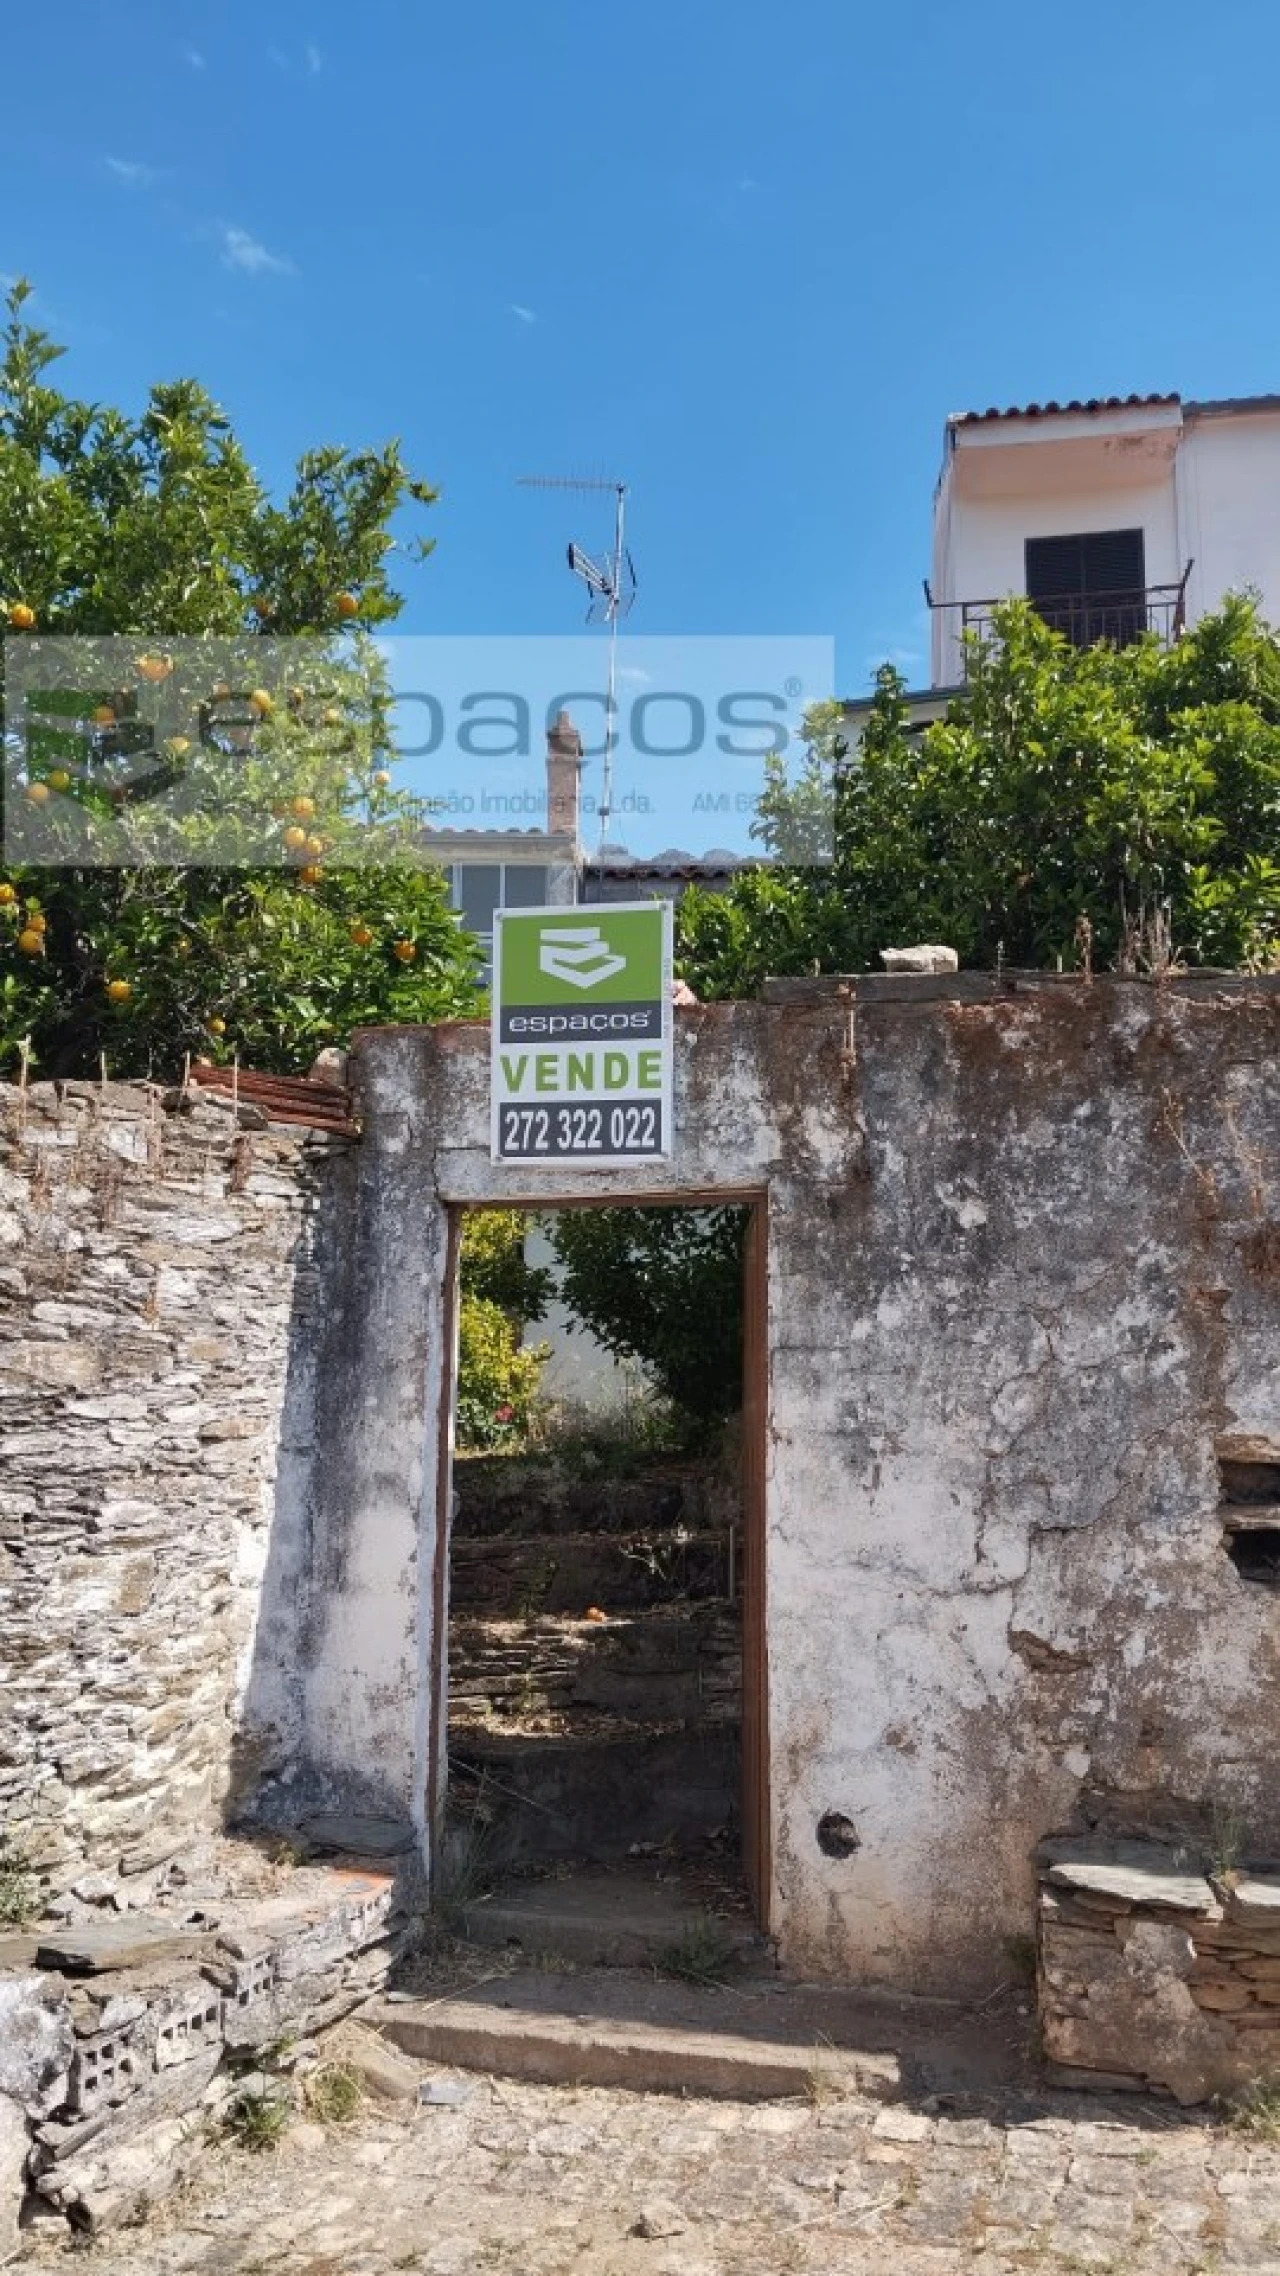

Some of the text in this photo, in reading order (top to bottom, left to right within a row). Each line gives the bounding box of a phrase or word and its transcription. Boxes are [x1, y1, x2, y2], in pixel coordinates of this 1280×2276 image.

[500, 1052, 662, 1092] VENDE
[504, 1106, 656, 1152] 272 322 022
